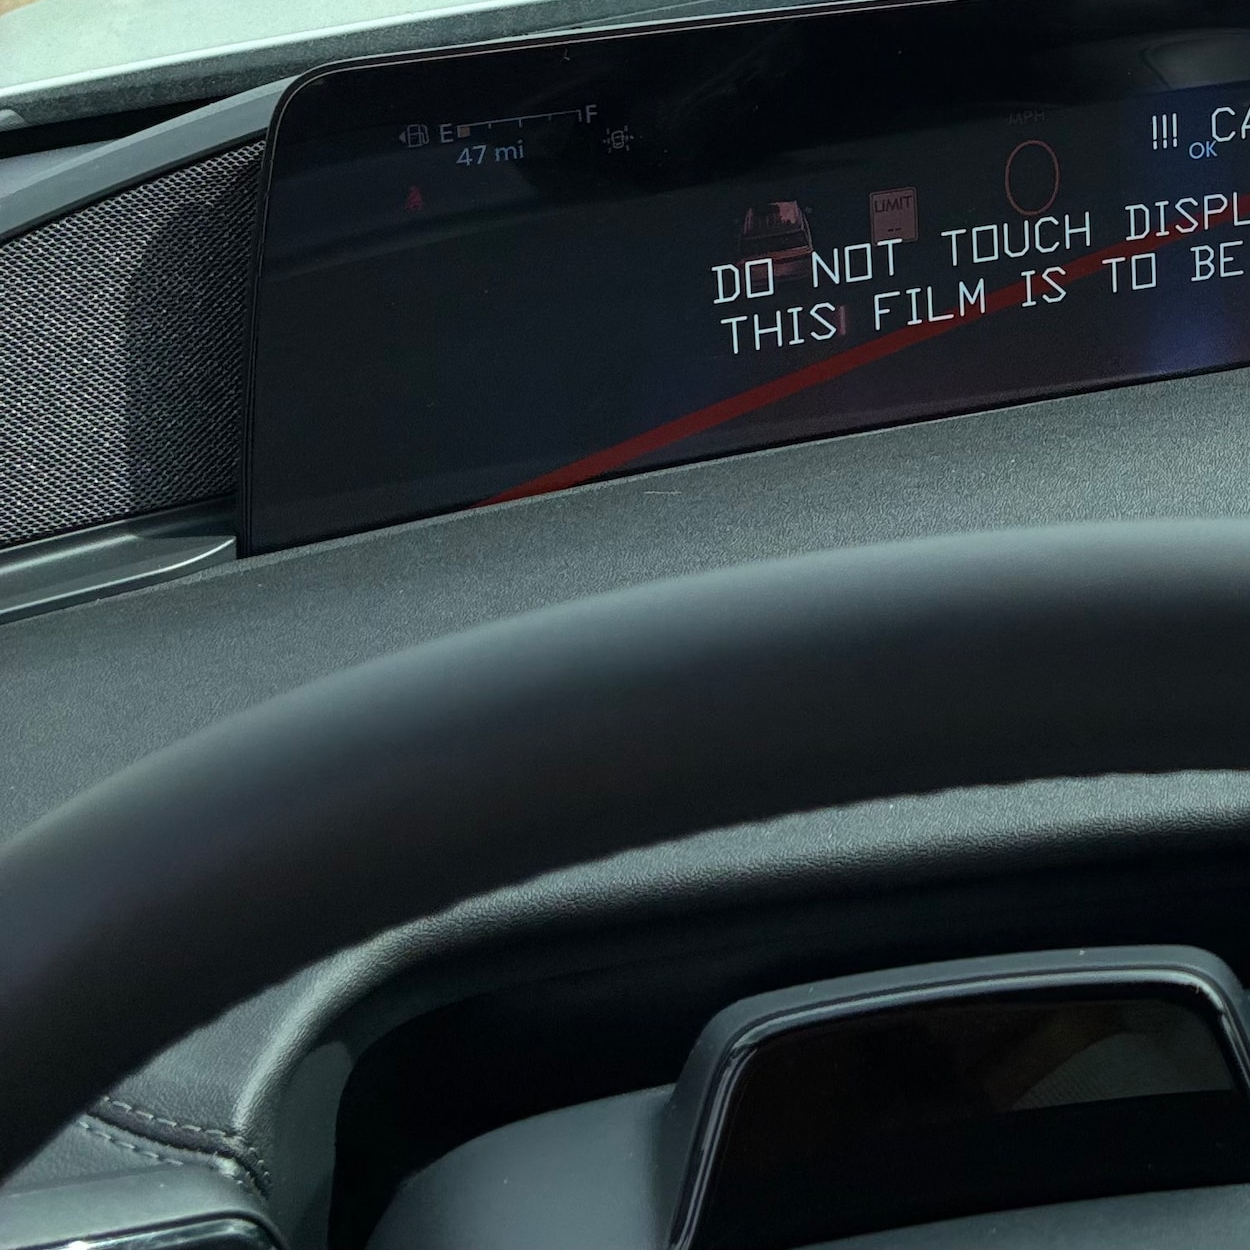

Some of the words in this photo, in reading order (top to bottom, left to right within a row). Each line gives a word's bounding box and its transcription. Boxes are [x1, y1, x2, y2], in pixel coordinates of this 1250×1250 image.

[586, 104, 598, 123] F
[1008, 110, 1046, 127] MPH
[439, 123, 454, 144] E
[456, 144, 488, 167] 47
[494, 139, 525, 163] mi
[1188, 141, 1218, 159] OK
[874, 195, 913, 213] LIMIT
[711, 258, 774, 304] DO
[811, 238, 903, 288] NOT
[941, 211, 1091, 266] TOUCH
[720, 302, 837, 354] THIS
[874, 278, 985, 331] FILM
[1021, 266, 1067, 307] IS
[1101, 252, 1157, 294] TO
[1190, 240, 1244, 282] BE
